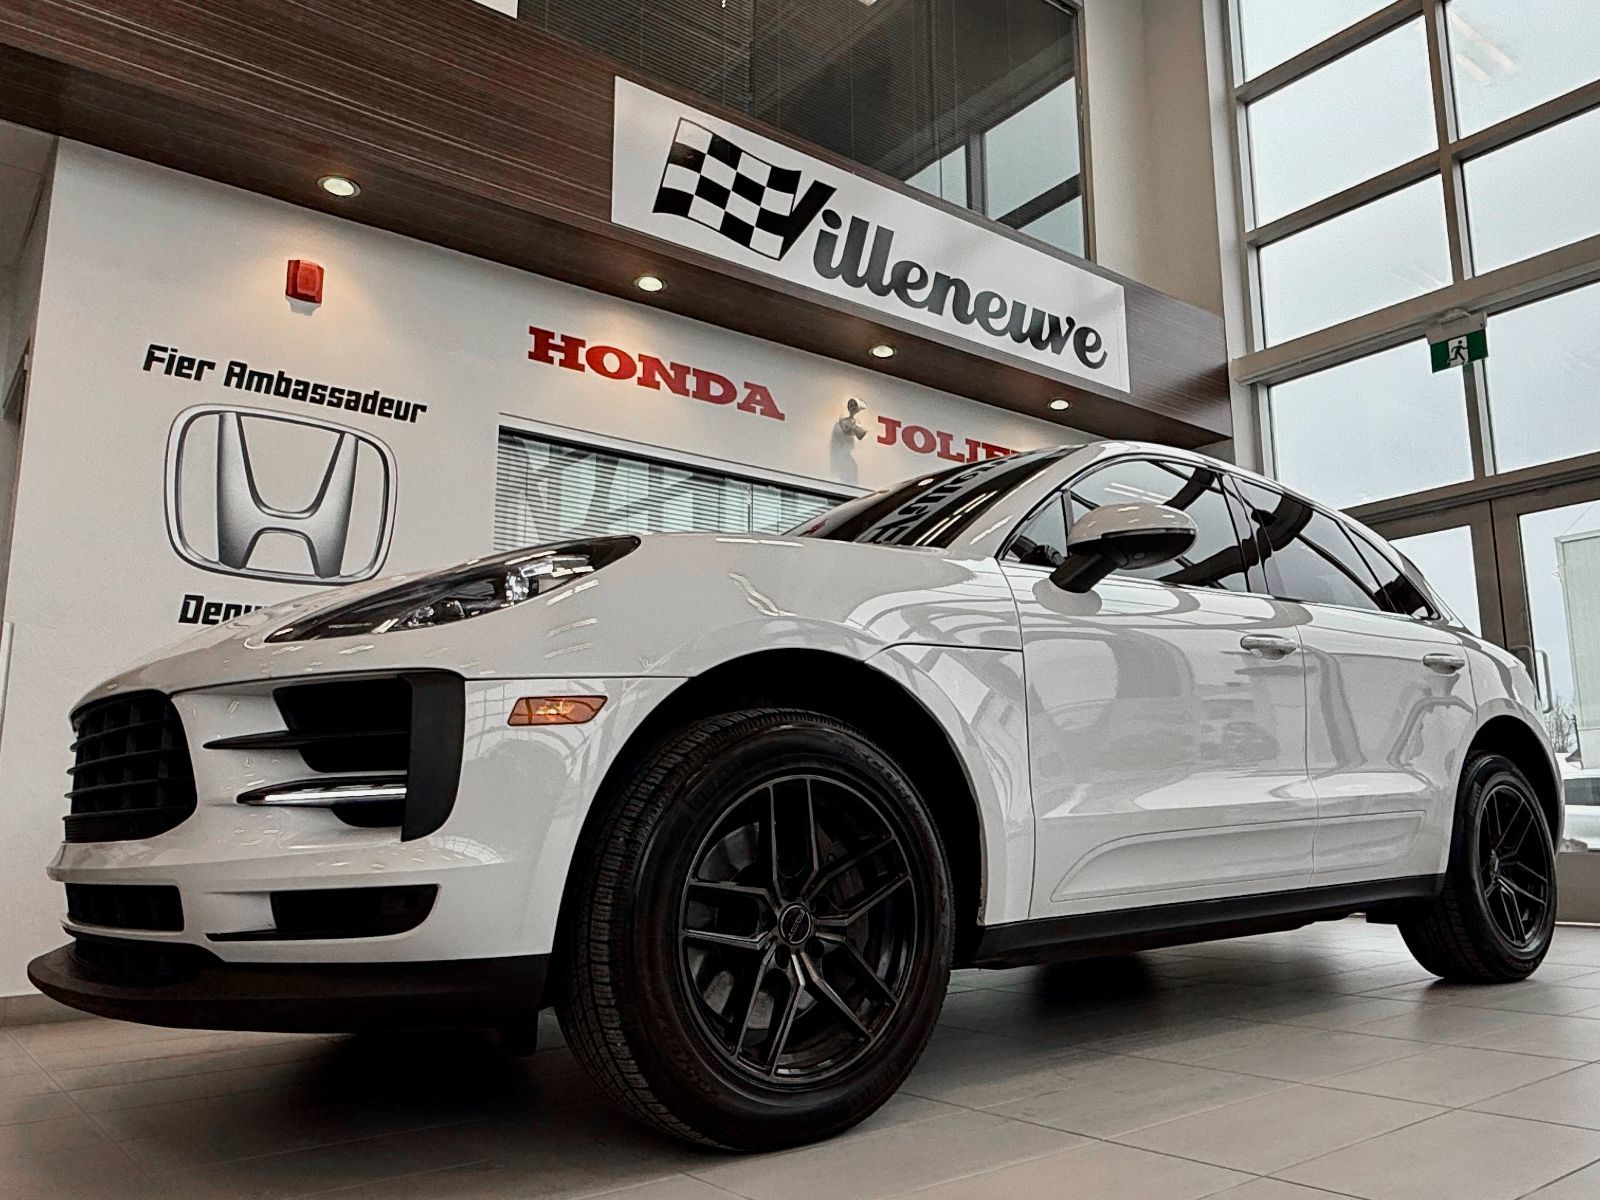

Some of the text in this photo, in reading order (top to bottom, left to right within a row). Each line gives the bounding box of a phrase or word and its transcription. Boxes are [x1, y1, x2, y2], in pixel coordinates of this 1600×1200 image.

[768, 174, 1108, 367] Villeneuve
[142, 343, 428, 424] Fier Ambassadeur
[528, 325, 1021, 463] HONDA JOLI
